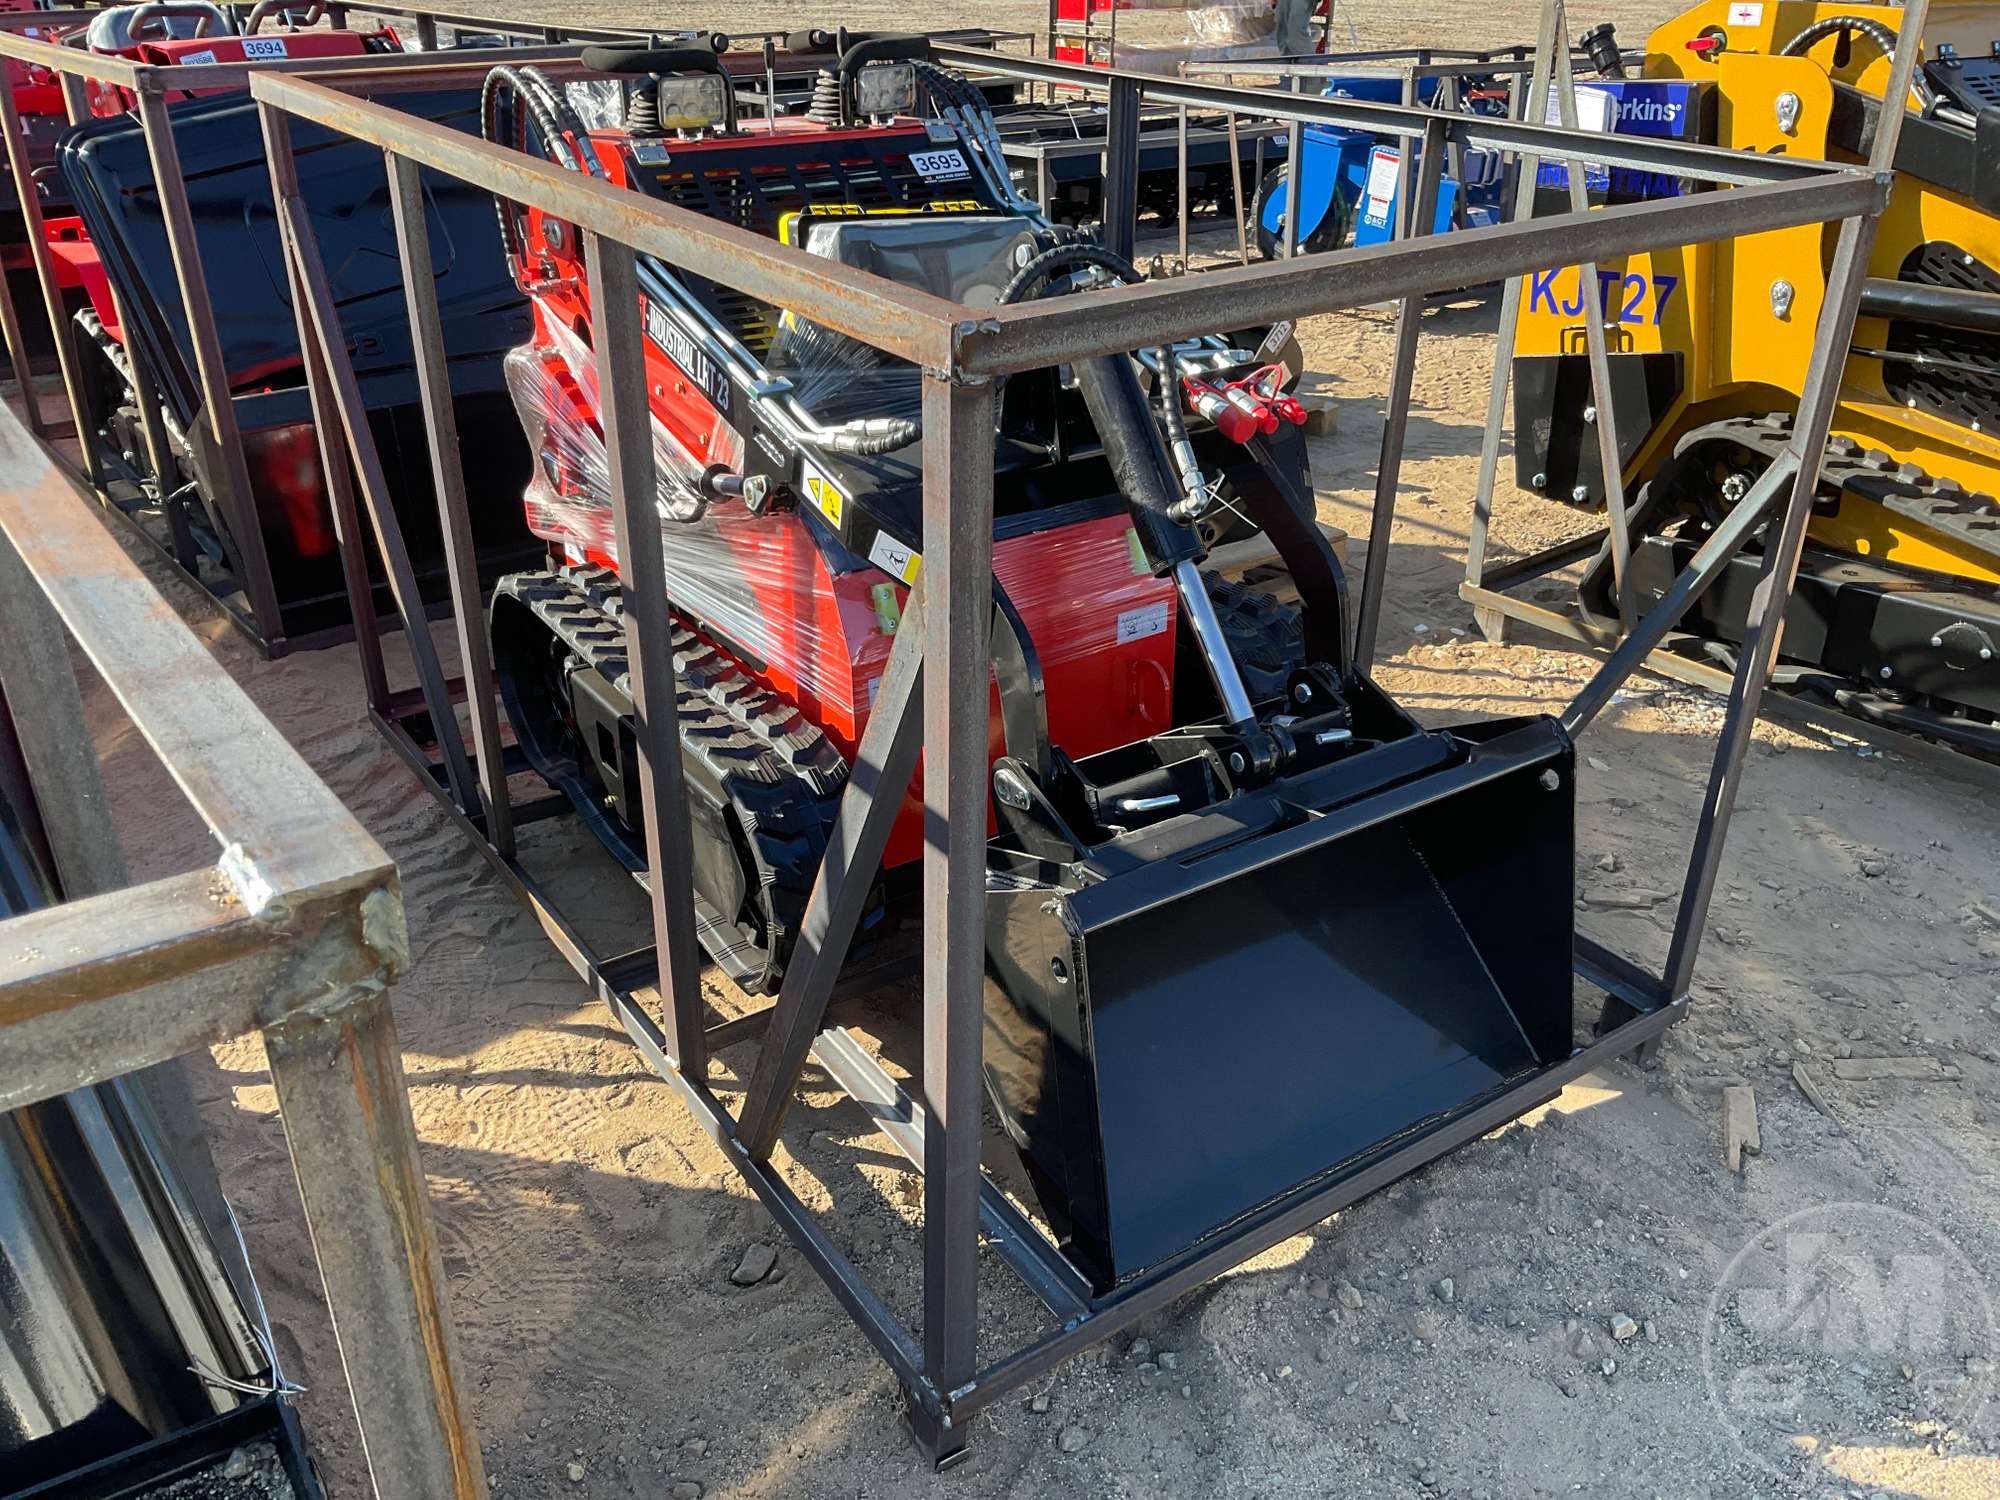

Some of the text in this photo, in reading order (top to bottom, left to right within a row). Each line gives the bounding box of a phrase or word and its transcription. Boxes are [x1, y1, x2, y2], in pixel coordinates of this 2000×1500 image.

[246, 43, 283, 54] 3694
[1615, 97, 1676, 122] erkins
[916, 154, 961, 171] 3695
[1270, 324, 1288, 347] 3712
[650, 306, 695, 375] INDUSTRIAL
[697, 349, 716, 396] LRT
[717, 372, 729, 411] 23
